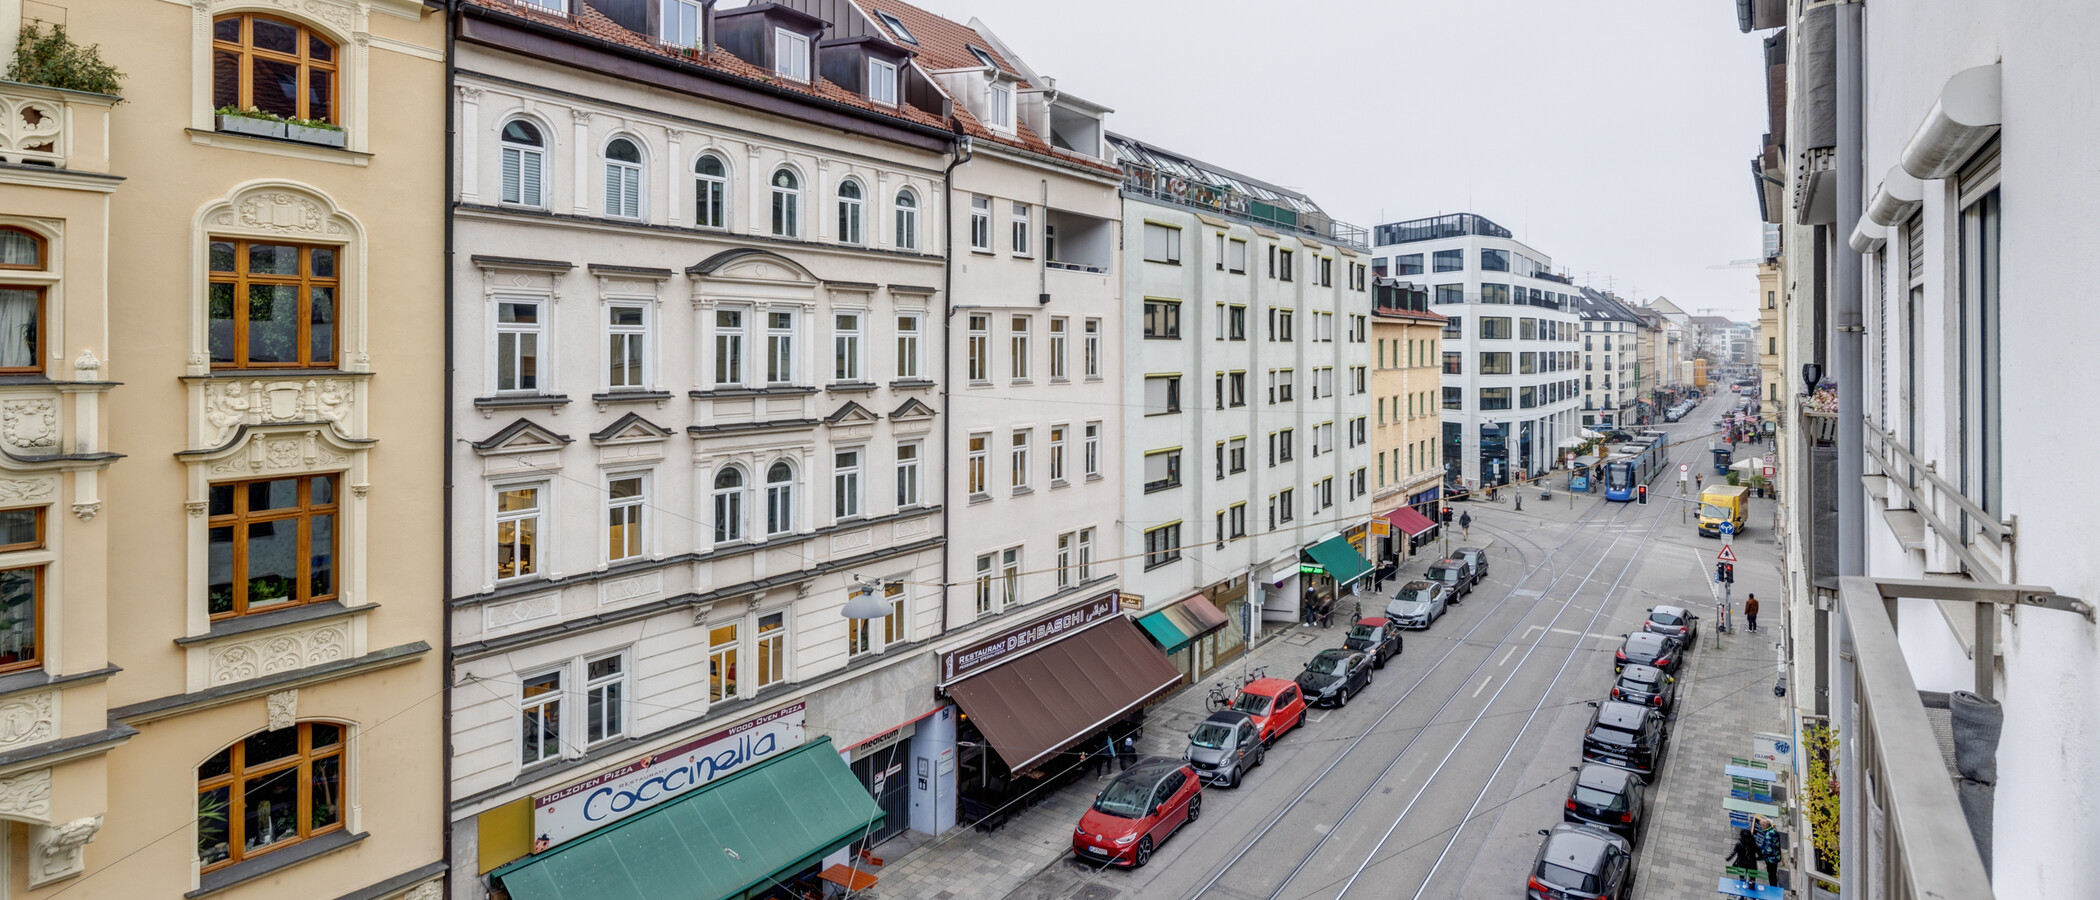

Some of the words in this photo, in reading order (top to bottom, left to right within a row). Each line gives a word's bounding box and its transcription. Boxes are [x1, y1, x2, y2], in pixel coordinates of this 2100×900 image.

[959, 640, 1006, 665] RESTAURANT
[1007, 610, 1084, 651] DEHBASCHI
[728, 722, 754, 735] WOOD
[756, 713, 778, 725] OVEN
[780, 704, 803, 717] PIZZA
[542, 778, 600, 805] HOLZOFEN
[603, 766, 633, 782] PIZZA
[583, 732, 776, 822] Coccinella
[618, 768, 668, 788] RESTAURANT
